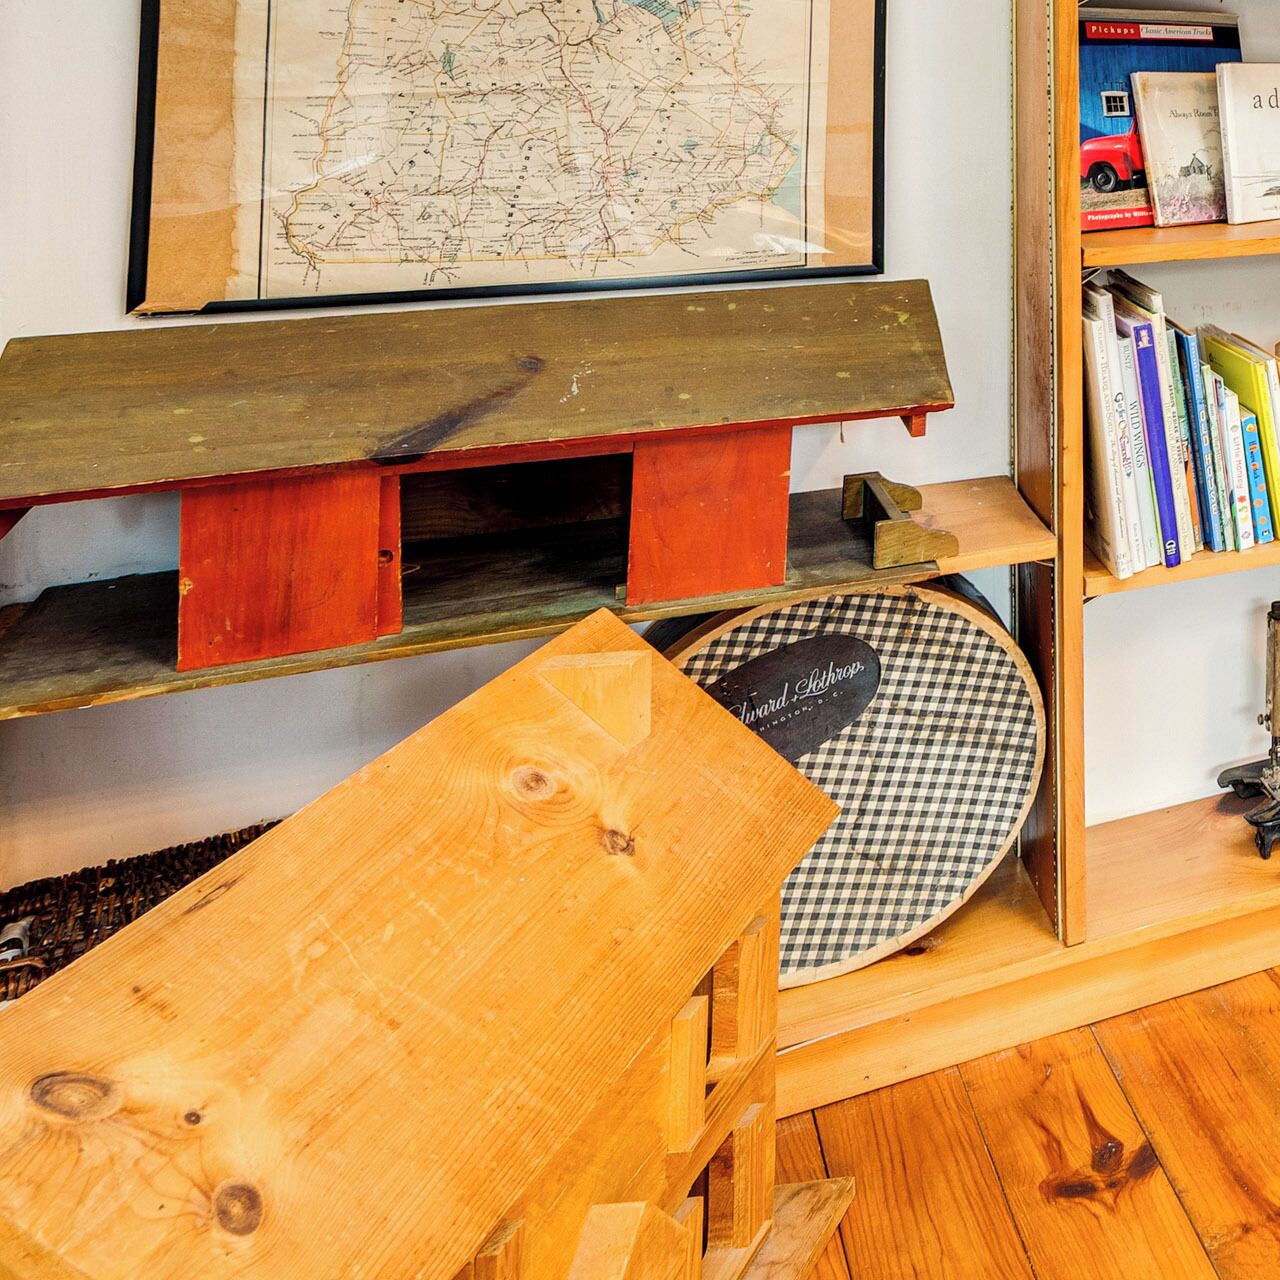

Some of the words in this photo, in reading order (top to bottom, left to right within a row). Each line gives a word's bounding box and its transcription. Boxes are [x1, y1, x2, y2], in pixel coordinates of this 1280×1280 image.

[1092, 26, 1134, 34] Pickups
[1253, 95, 1262, 109] a
[1129, 400, 1140, 431] WILD
[1133, 432, 1145, 468] WINGS
